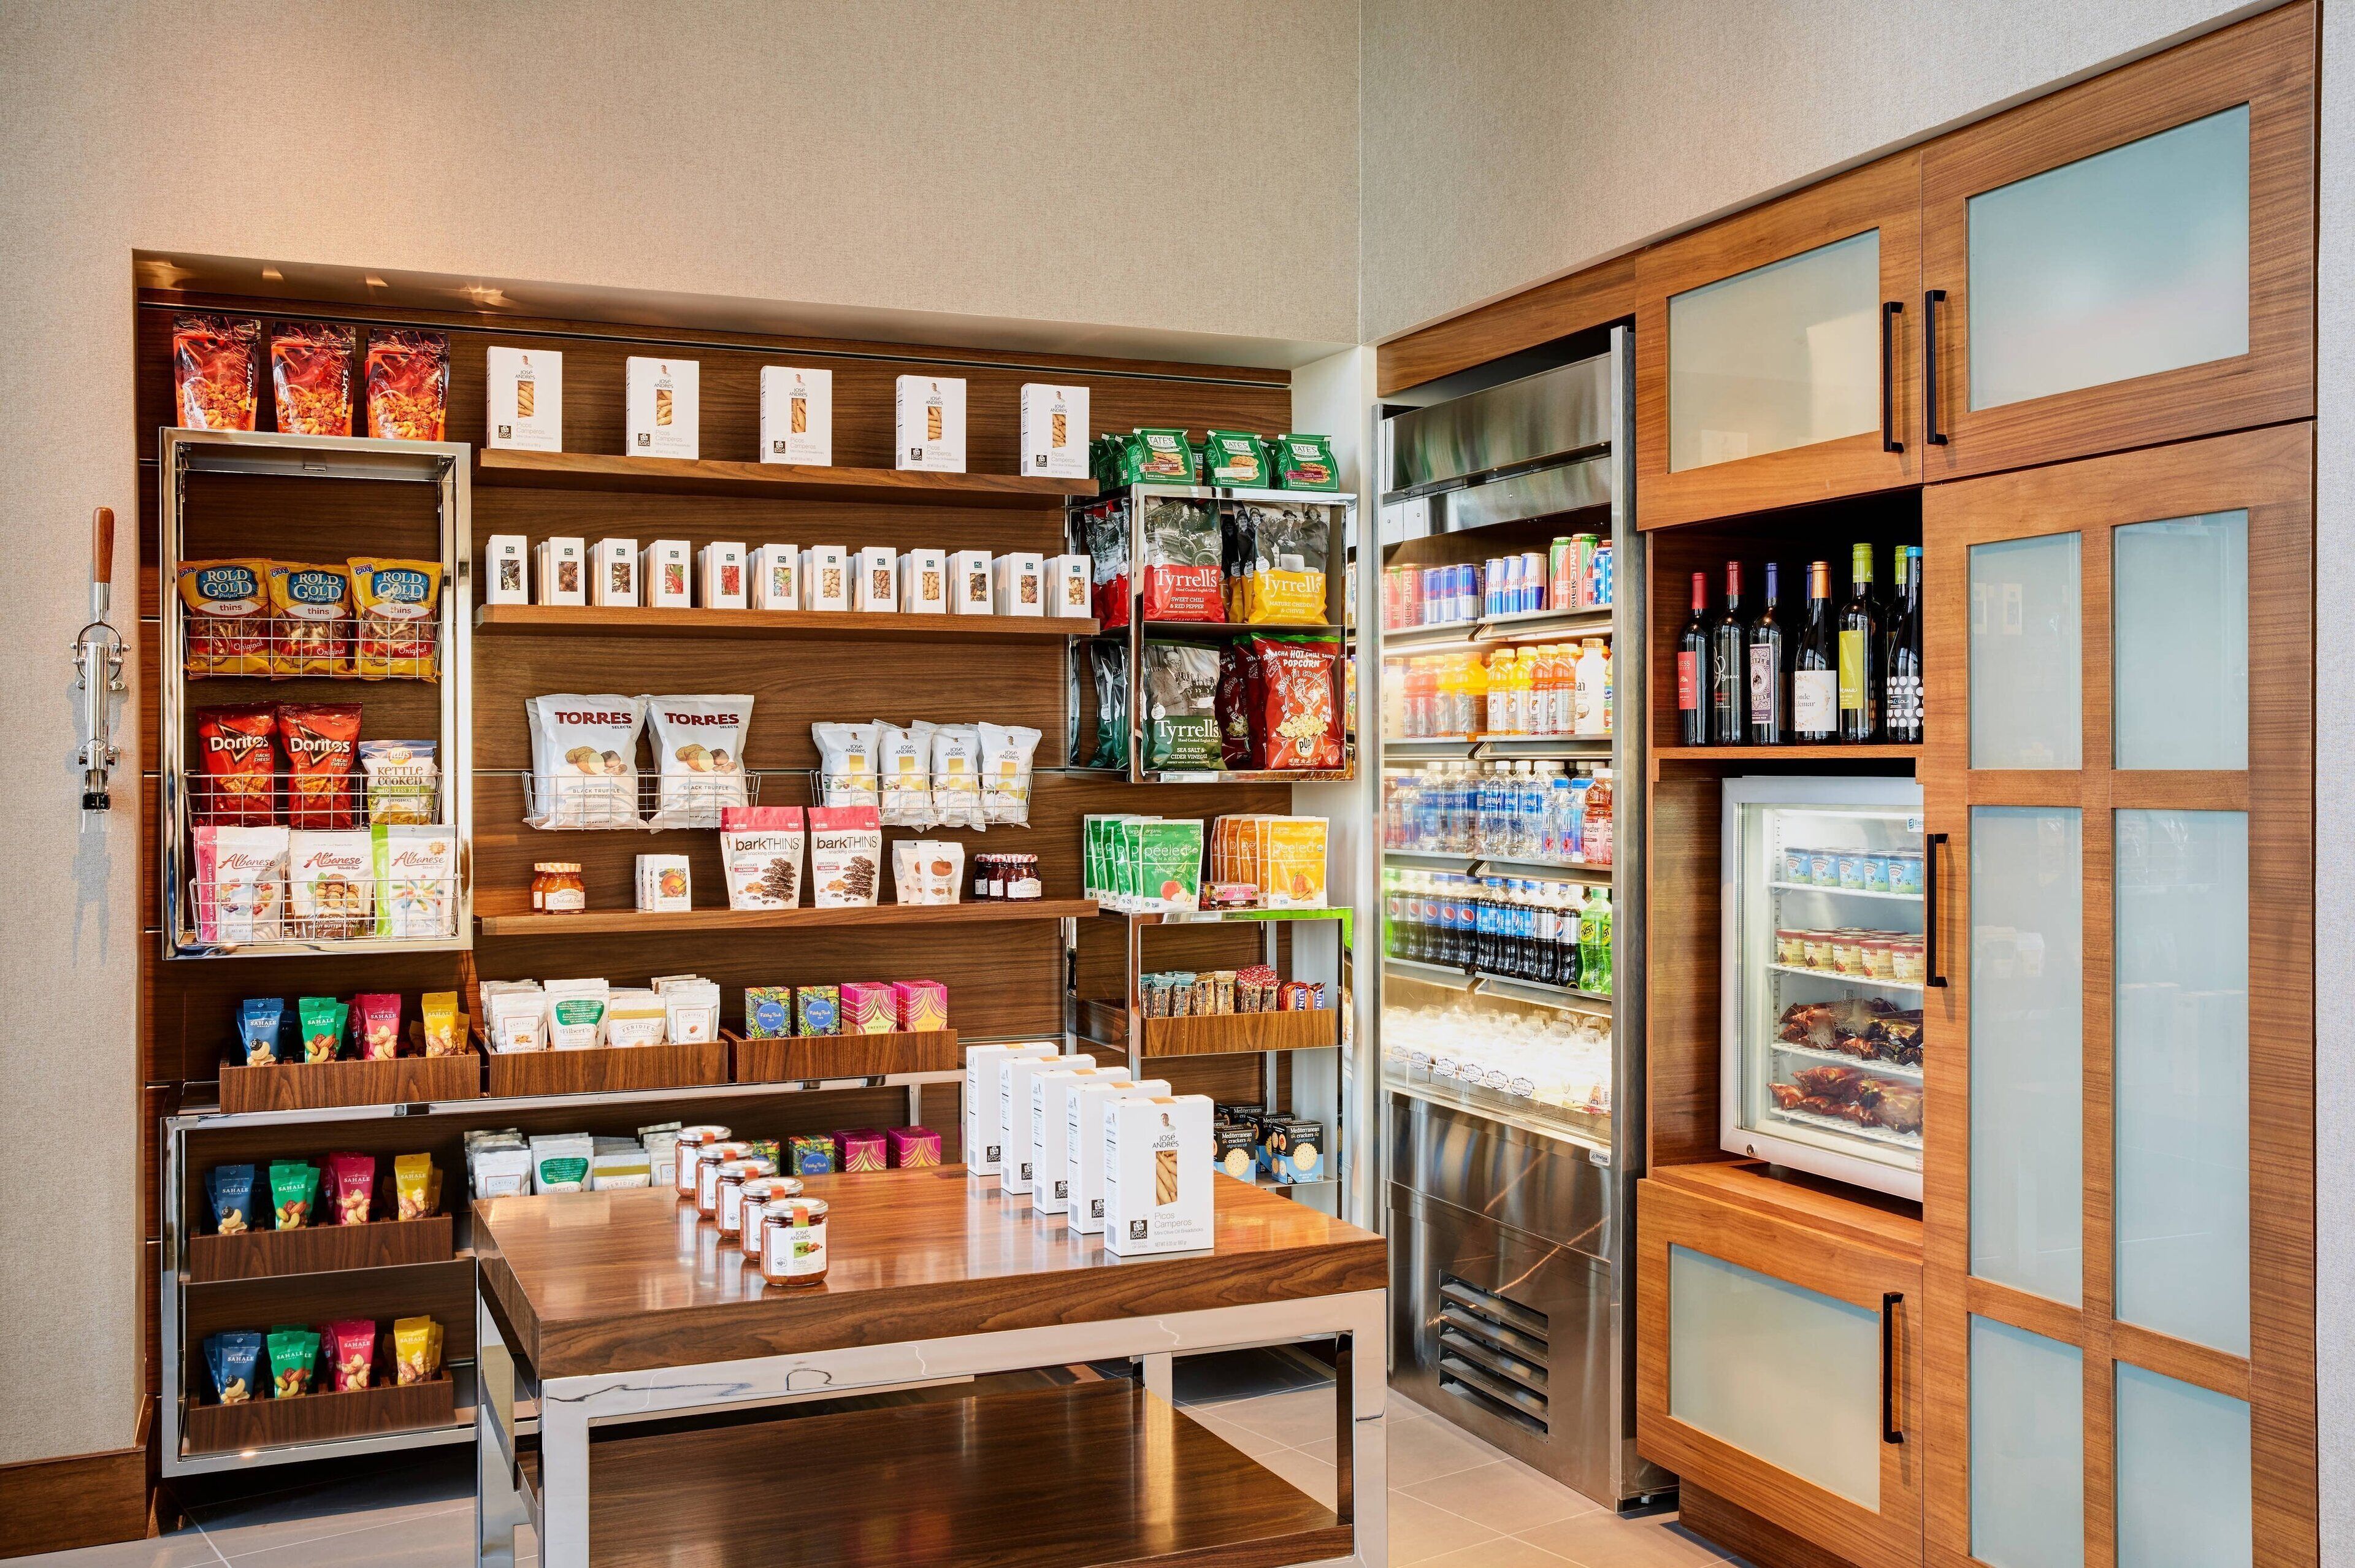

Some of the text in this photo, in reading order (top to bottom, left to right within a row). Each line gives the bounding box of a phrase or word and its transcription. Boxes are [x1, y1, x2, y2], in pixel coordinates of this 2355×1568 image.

[245, 362, 254, 411] PEANUTS
[341, 369, 350, 417] PEANUTS
[1148, 436, 1174, 445] TATE'S
[271, 568, 291, 578] GRAB
[354, 563, 373, 572] HUNGER
[355, 566, 375, 575] GRAB
[207, 568, 249, 582] ROLD
[297, 572, 340, 586] ROLD
[380, 570, 423, 585] ROLD
[203, 581, 252, 596] GOLD
[294, 586, 342, 600] GOLD
[377, 583, 424, 600] GOLD
[219, 603, 243, 612] thins
[390, 605, 412, 614] thins
[233, 641, 264, 652] Original
[316, 646, 345, 656] Original
[397, 644, 428, 655] Original
[1290, 650, 1304, 659] HOT
[1282, 659, 1320, 667] POPCORN
[555, 711, 632, 724] TORRES
[664, 712, 740, 725] TORRES
[210, 735, 269, 752] Doritos
[290, 736, 351, 753] Doritos
[736, 837, 800, 851] barkTHINS
[817, 836, 878, 849] barkTHINS
[1273, 841, 1314, 857] peeled
[1144, 844, 1188, 859] peeled
[218, 853, 276, 870] Albanese
[304, 852, 363, 870] Albanese
[391, 851, 446, 866] Albanese
[606, 1182, 640, 1190] FERIDIES
[1154, 1219, 1192, 1229] Camperos
[276, 1352, 304, 1360] SAHALE
